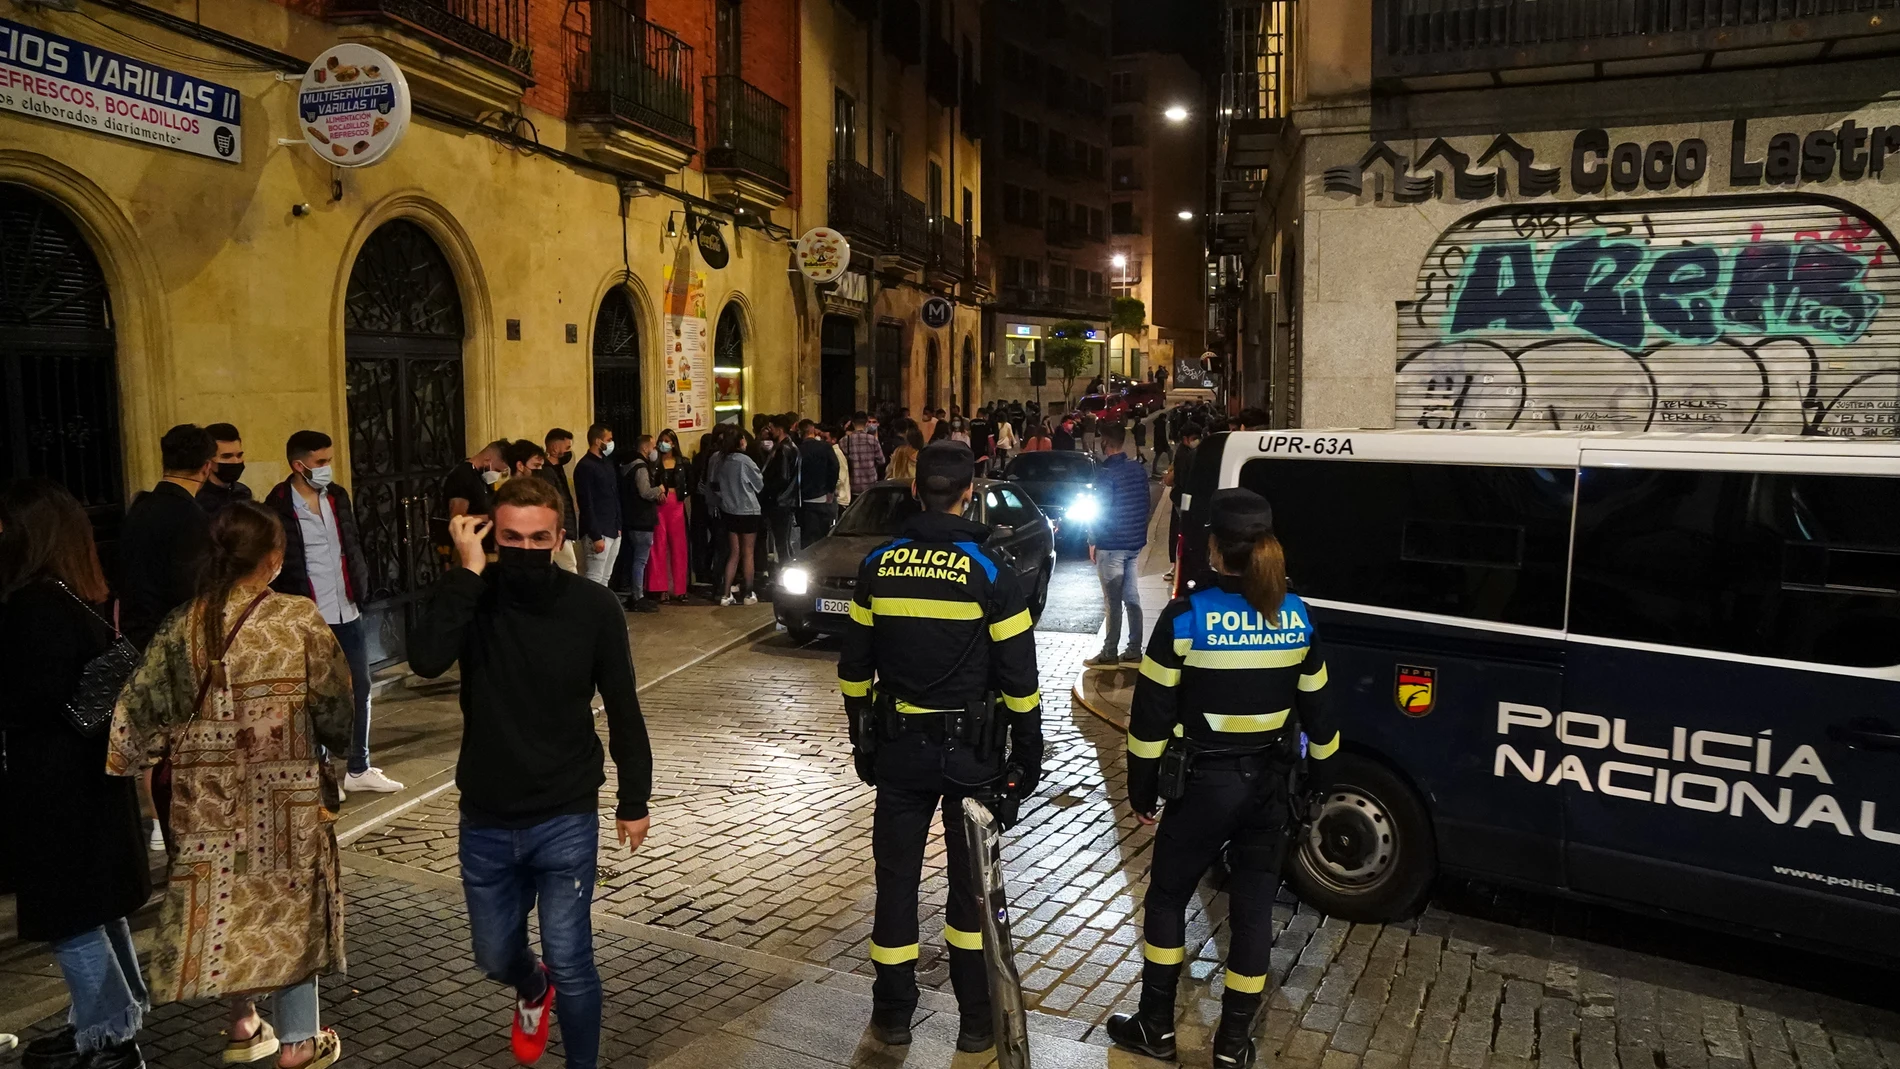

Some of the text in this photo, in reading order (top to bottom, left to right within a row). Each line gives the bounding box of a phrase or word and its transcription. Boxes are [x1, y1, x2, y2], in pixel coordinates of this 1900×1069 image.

[83, 51, 215, 114] VARILLAS
[222, 92, 237, 119] II
[303, 84, 389, 104] MULTISERVICIOS
[21, 96, 98, 126] elaborados
[105, 95, 200, 135] BOCADILLOS
[318, 99, 367, 115] VARILLAS
[328, 121, 370, 132] BOCADILLOS
[330, 129, 370, 139] REFRESCOS
[1571, 127, 1708, 195] Coco
[1257, 435, 1354, 456] UPR-63A
[880, 548, 971, 573] POLICIA
[877, 566, 967, 585] SALAMANCA
[824, 601, 850, 613] 6206
[1206, 632, 1306, 646] SALAMANCA
[1493, 743, 1900, 846] NACIONAL
